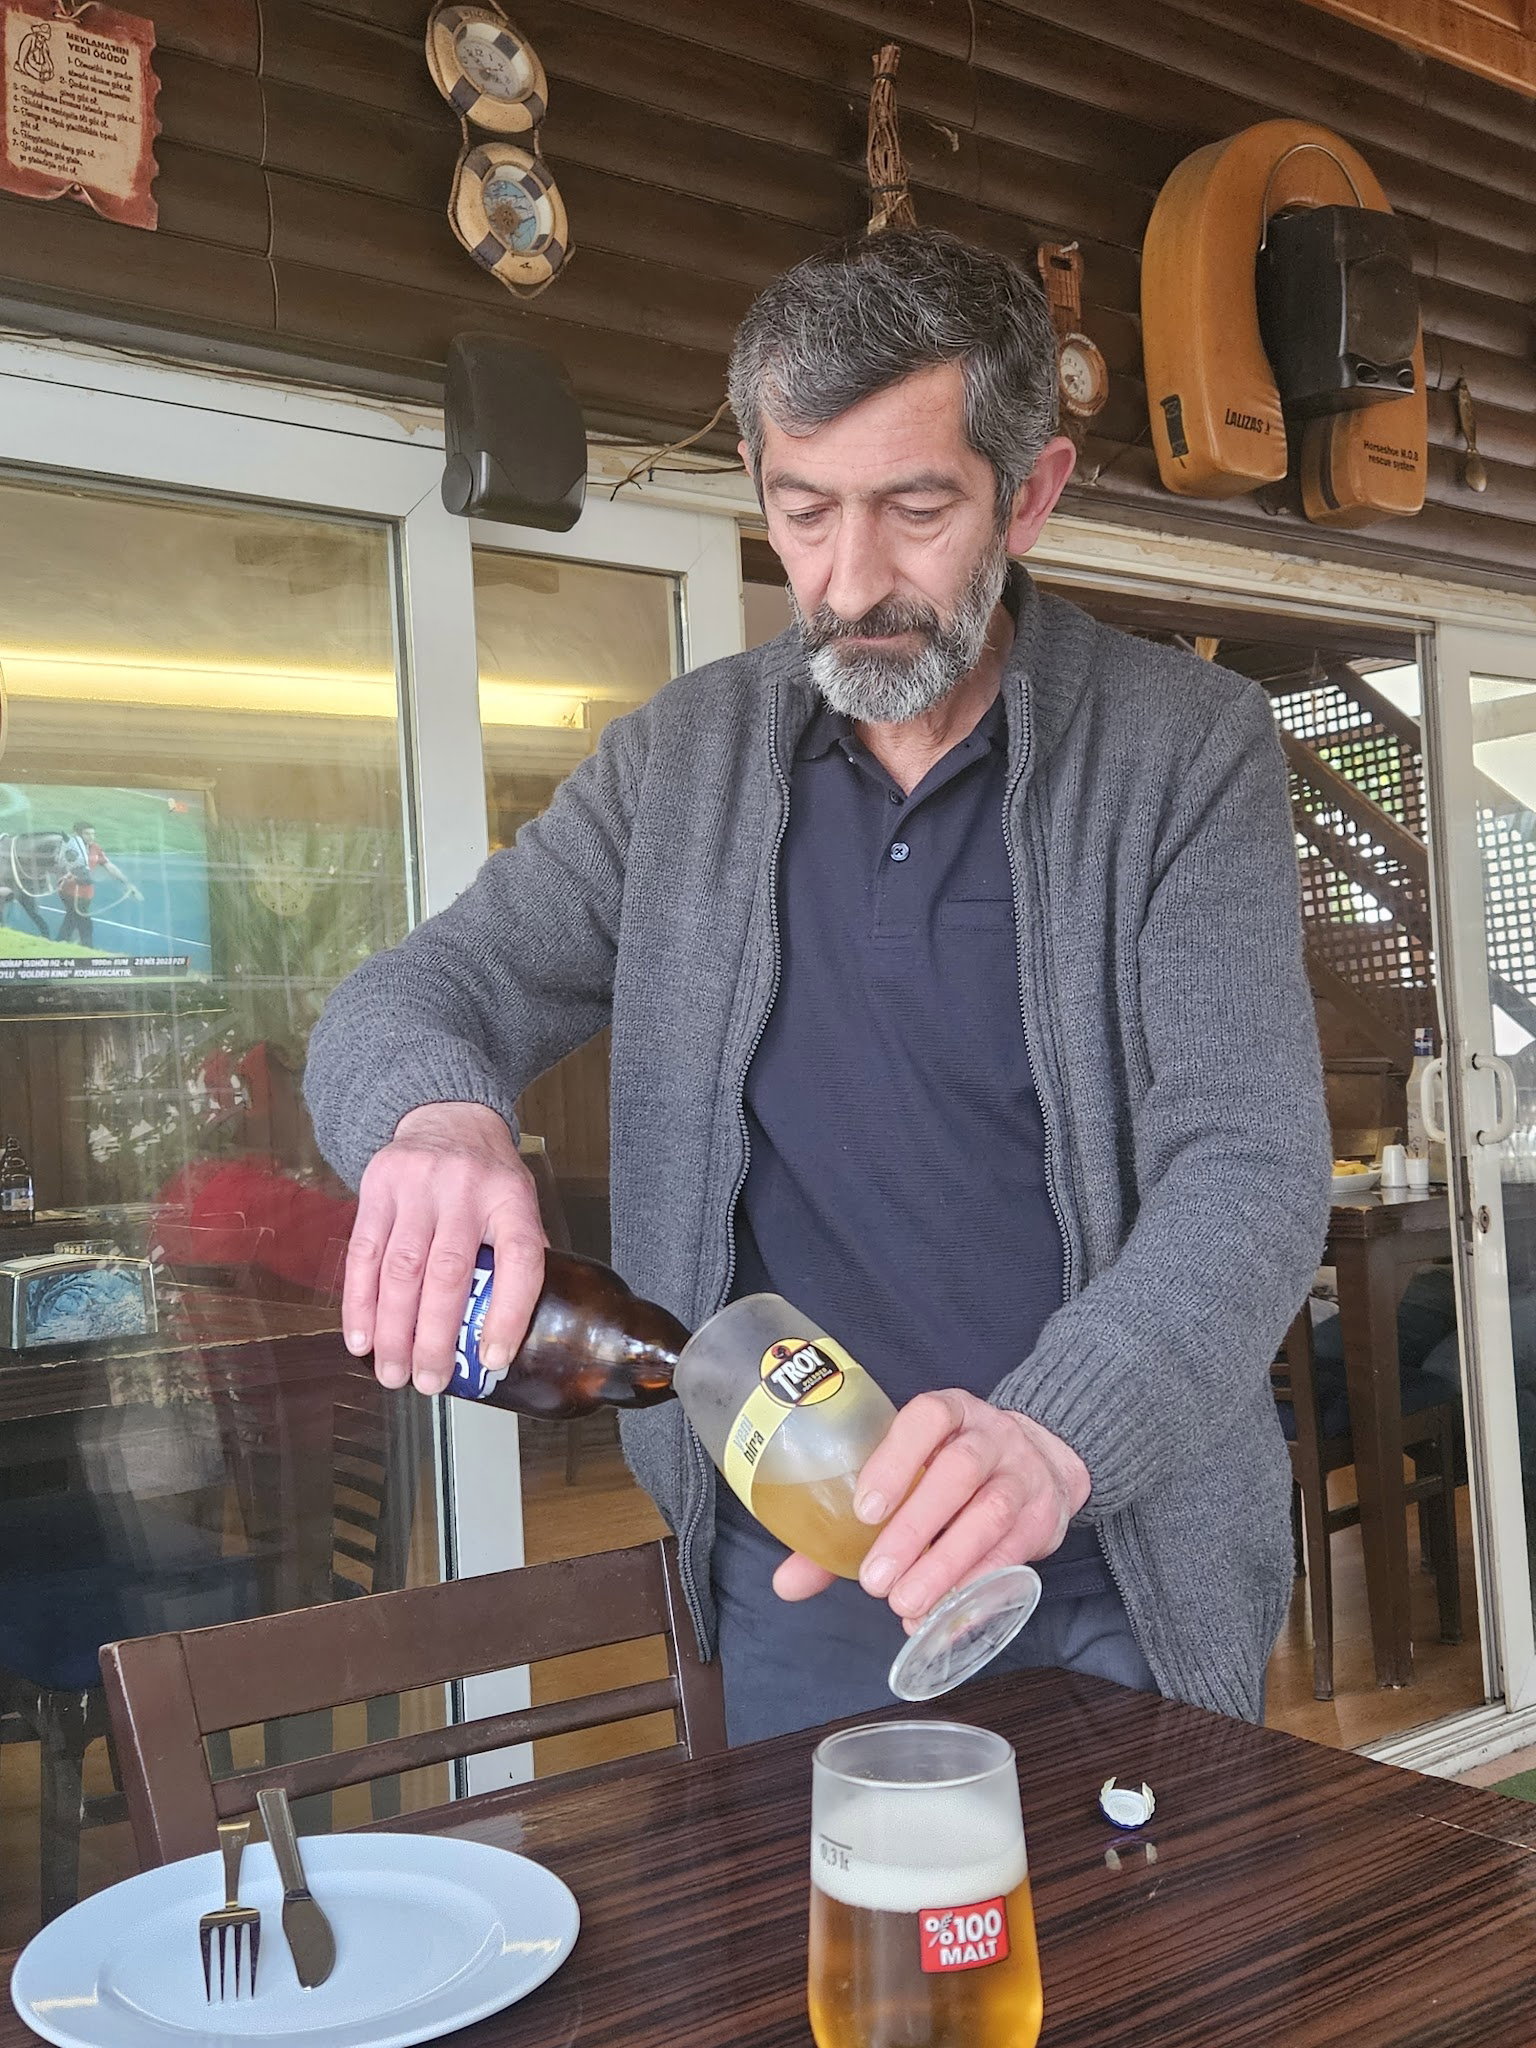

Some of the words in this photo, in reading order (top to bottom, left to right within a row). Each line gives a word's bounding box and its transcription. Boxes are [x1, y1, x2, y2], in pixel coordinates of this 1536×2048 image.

[68, 42, 90, 56] YEDİ
[93, 49, 127, 65] ÖĞÜDÜ
[1224, 408, 1263, 434] LALIZAS
[1363, 439, 1399, 457] Horseshoe
[1368, 454, 1391, 467] rescue
[1393, 460, 1416, 472] system
[770, 1345, 826, 1401] TROY
[743, 1430, 765, 1466] bira
[925, 1908, 1002, 1948] %100
[939, 1937, 997, 1966] MALT
